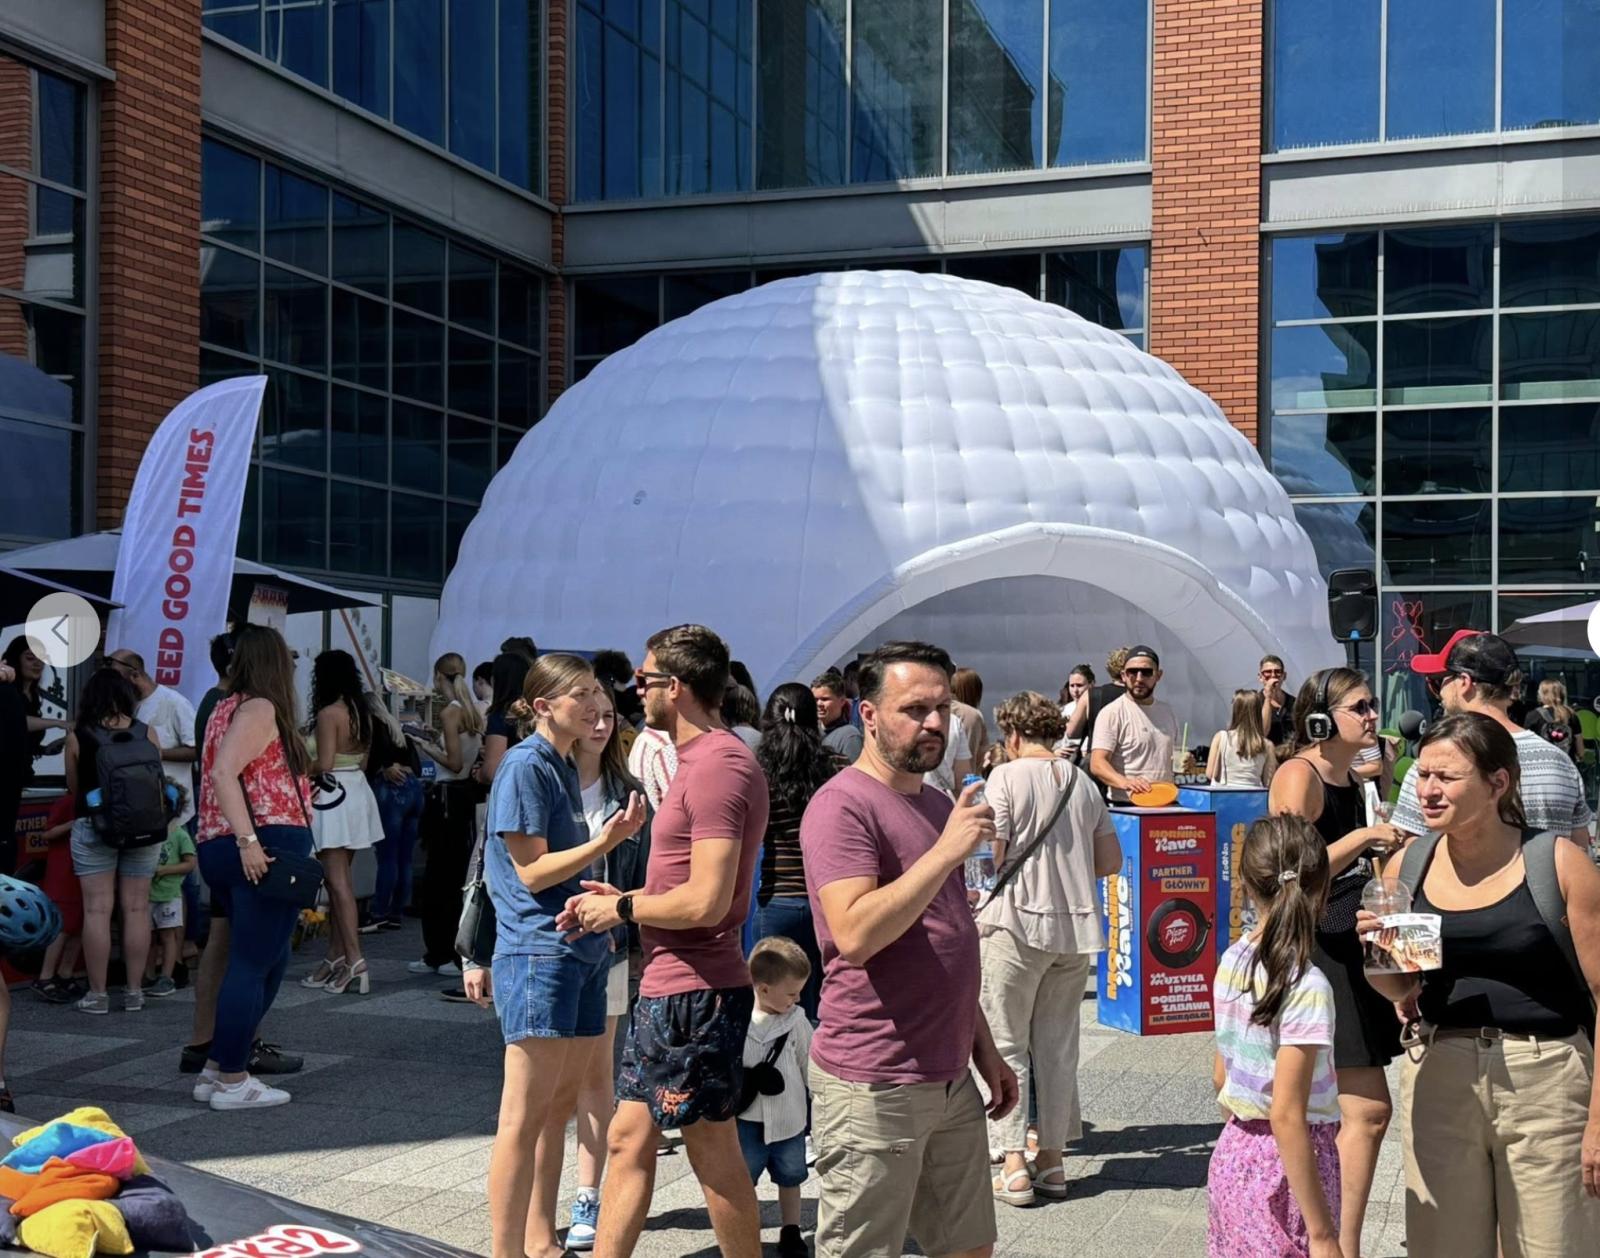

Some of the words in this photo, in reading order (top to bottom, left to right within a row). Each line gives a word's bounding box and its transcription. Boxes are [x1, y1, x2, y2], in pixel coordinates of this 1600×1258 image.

[177, 428, 215, 518] TIMES
[162, 525, 196, 621] GOOD
[155, 628, 184, 686] EED
[1174, 773, 1207, 785] ave
[15, 816, 48, 832] RTNER
[1155, 838, 1197, 852] Rave
[1152, 866, 1193, 877] PARTNER
[1107, 873, 1118, 1000] MORNIN
[1115, 875, 1132, 987] Rave
[1174, 984, 1208, 993] PIZZA
[1150, 994, 1193, 1005] DOBRA
[1161, 1001, 1210, 1012] ZABAWA
